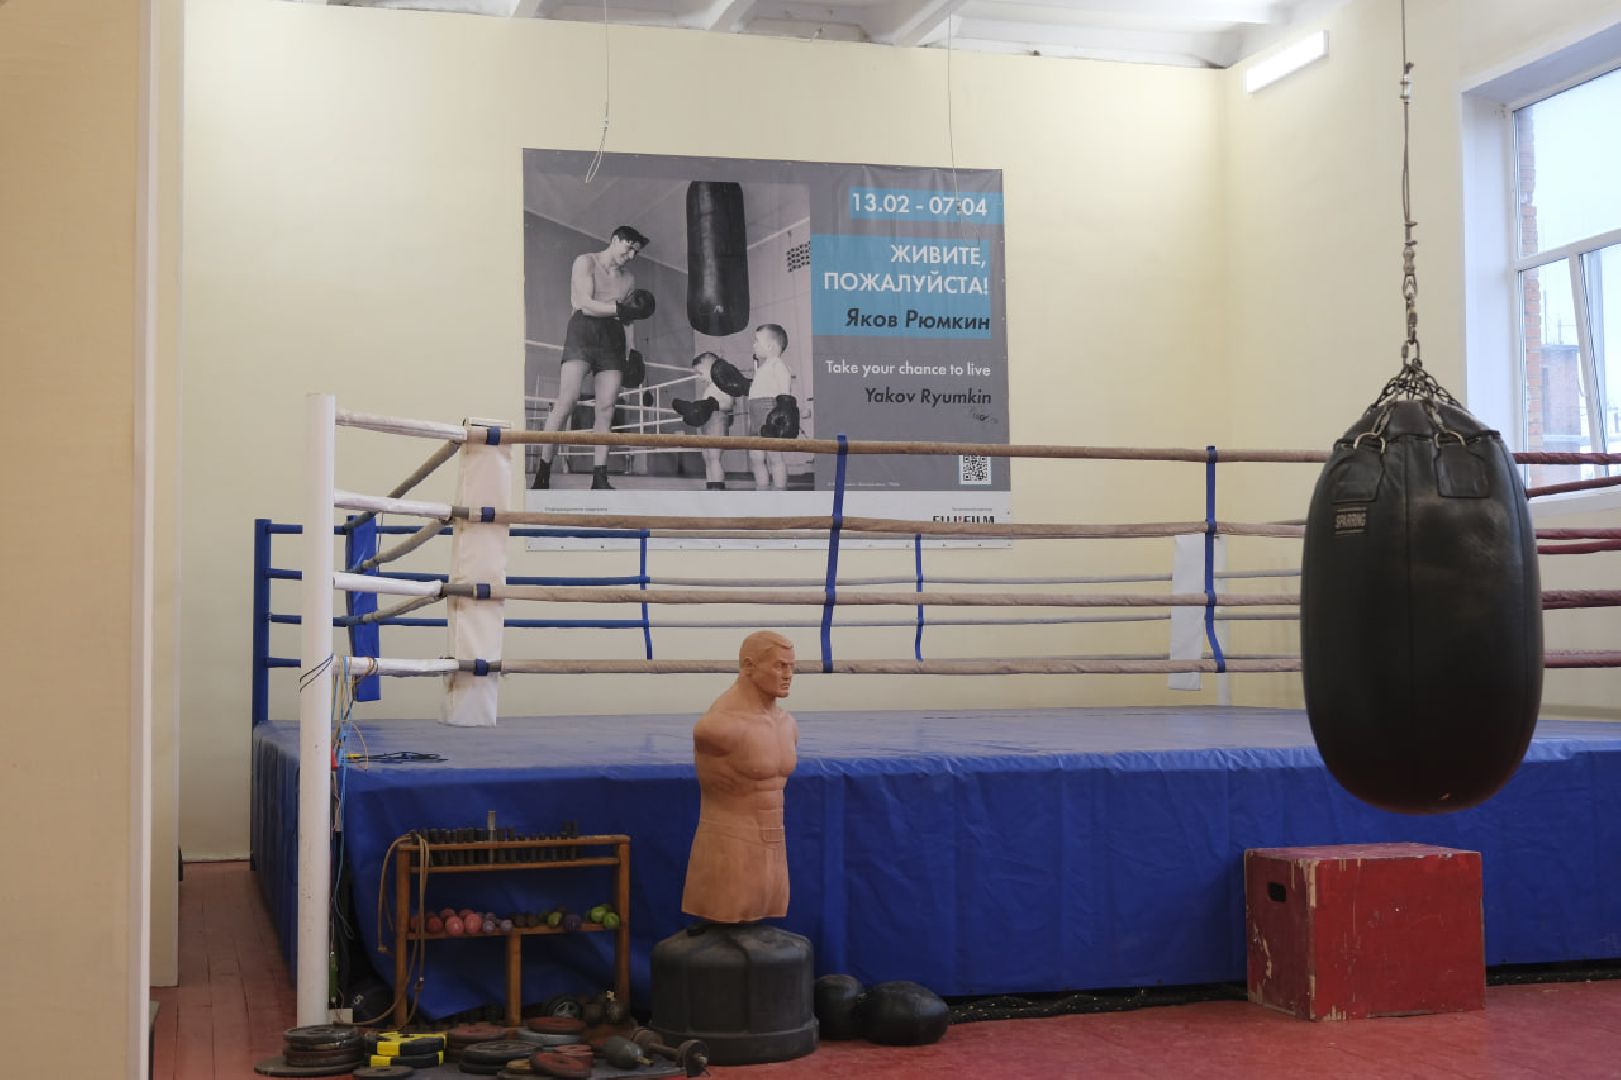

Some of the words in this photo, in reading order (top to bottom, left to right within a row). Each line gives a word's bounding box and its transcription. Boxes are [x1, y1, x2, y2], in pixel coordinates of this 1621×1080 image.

[852, 192, 910, 214] 13.02
[890, 244, 986, 269] ЖИВИТЕ,
[824, 270, 988, 297] ПОЖАЛУЙСТА!
[845, 308, 897, 328] Яков
[905, 310, 990, 330] Рюмкин
[825, 360, 858, 375] Take
[863, 363, 895, 378] your
[899, 361, 946, 375] chance
[950, 363, 963, 376] to
[967, 362, 991, 377] live
[865, 387, 915, 404] Yakov
[921, 388, 992, 407] Ryumkin
